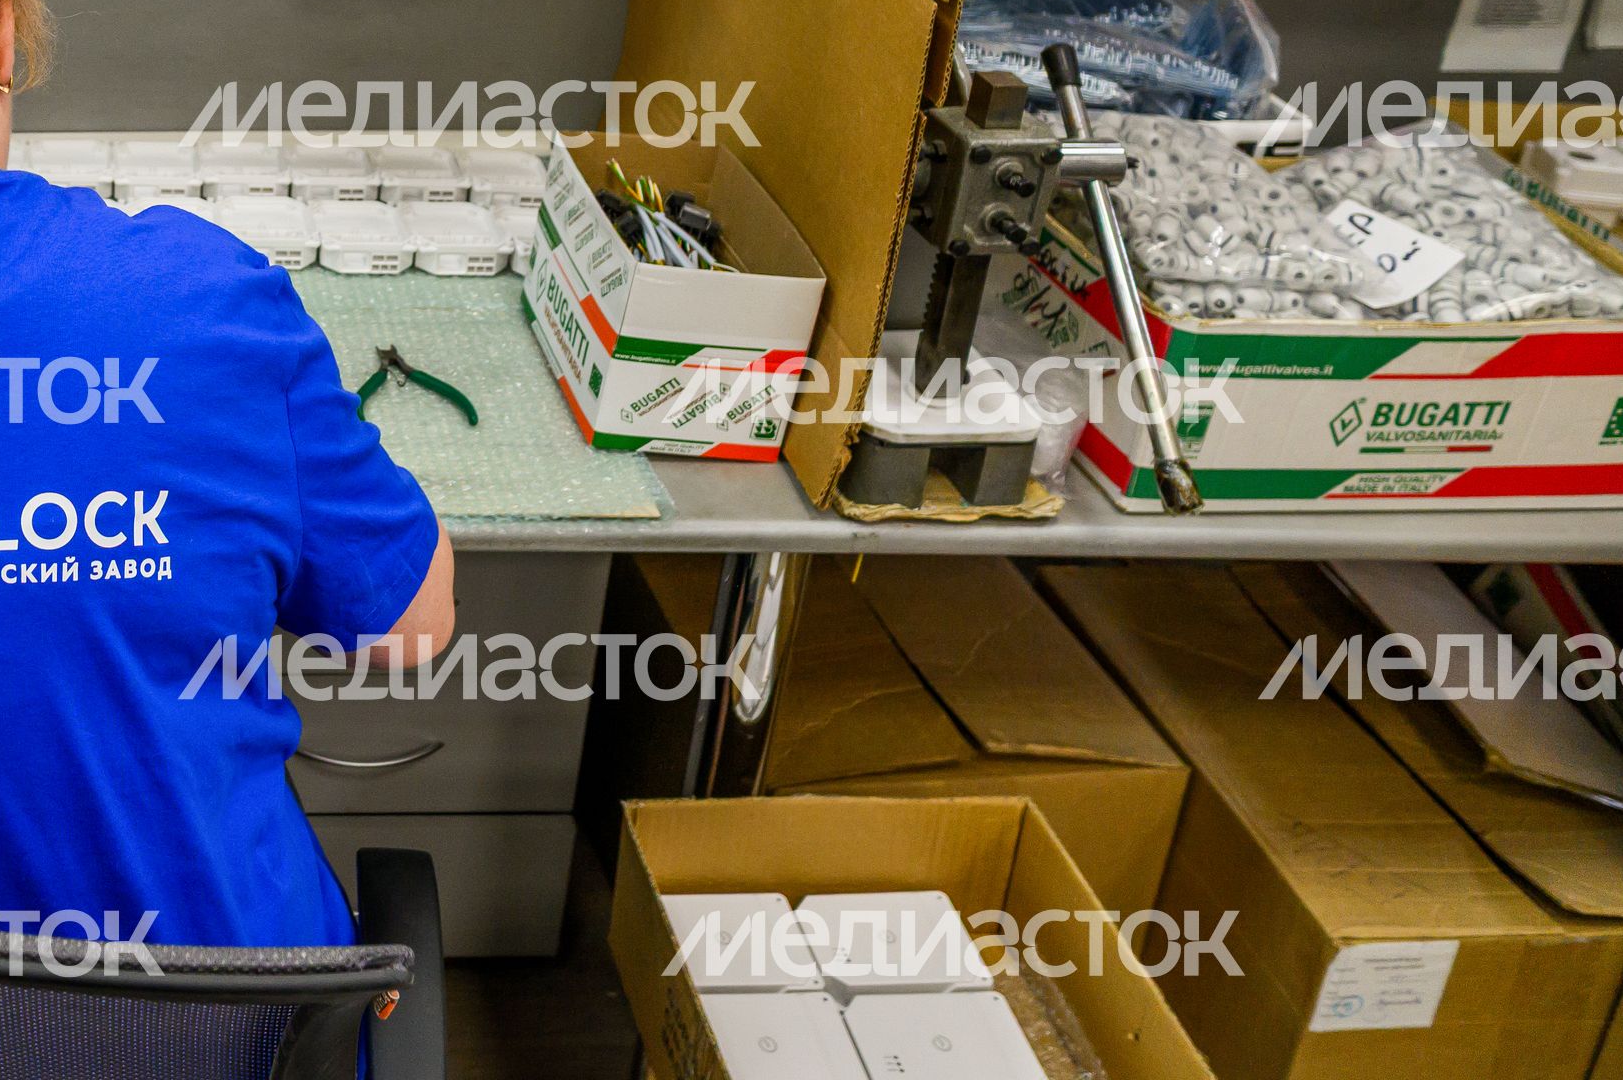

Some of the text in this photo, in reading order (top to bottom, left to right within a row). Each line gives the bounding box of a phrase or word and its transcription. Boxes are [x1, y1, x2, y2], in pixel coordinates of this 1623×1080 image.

[547, 273, 590, 367] BUGATTI
[630, 377, 681, 413] BUGATTI
[672, 394, 722, 429] BUGATTI
[727, 384, 776, 421] BUGATTI
[1370, 401, 1512, 427] BUGATTI
[88, 556, 173, 582] ЗАВОД
